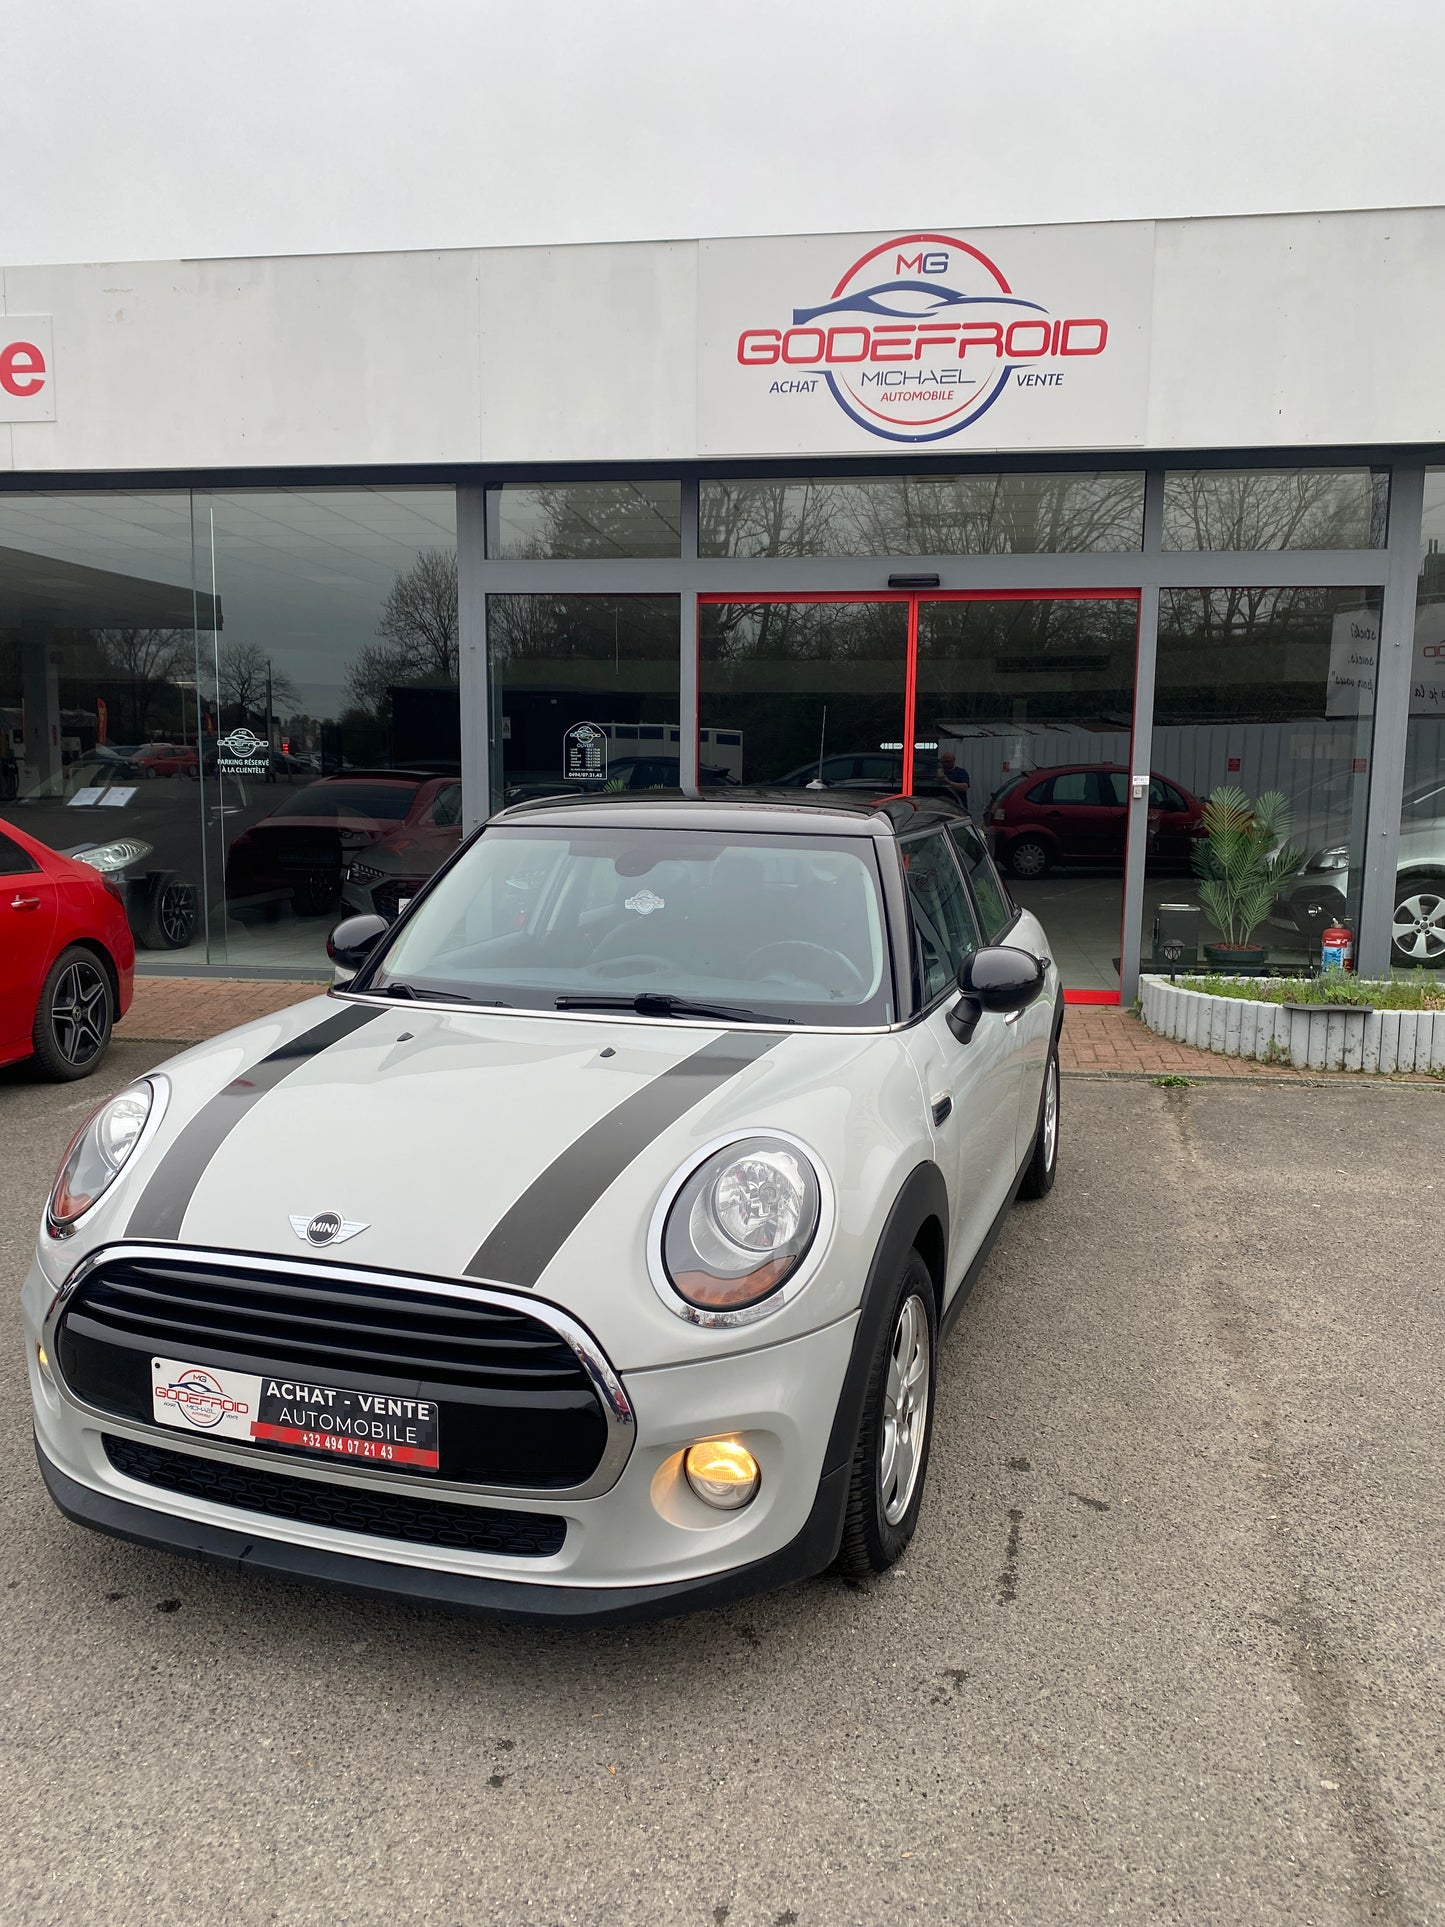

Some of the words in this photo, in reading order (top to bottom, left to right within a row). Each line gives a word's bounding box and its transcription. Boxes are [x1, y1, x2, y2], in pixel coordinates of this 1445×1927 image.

[895, 252, 949, 275] MG
[737, 318, 1109, 366] GODEFROID
[861, 368, 976, 387] MICHAEL
[1016, 372, 1065, 387] VENTE
[768, 379, 819, 394] ACHAT
[880, 389, 954, 402] AUTOMOBILE
[217, 758, 243, 766] PARKING
[244, 758, 270, 766] RÉSERVÉ
[235, 766, 266, 774] CLIENTÈLE
[309, 1221, 338, 1234] MINI
[192, 1373, 207, 1384] MG
[154, 1386, 249, 1415] GODEFROID
[266, 1381, 337, 1407] ACHAT
[358, 1395, 431, 1421] VENTE
[279, 1407, 418, 1444] AUTOMOBILE
[302, 1433, 321, 1447] +32
[325, 1436, 344, 1451] 494
[347, 1440, 361, 1454] 07
[364, 1442, 376, 1457] 21
[380, 1445, 394, 1459] 43
